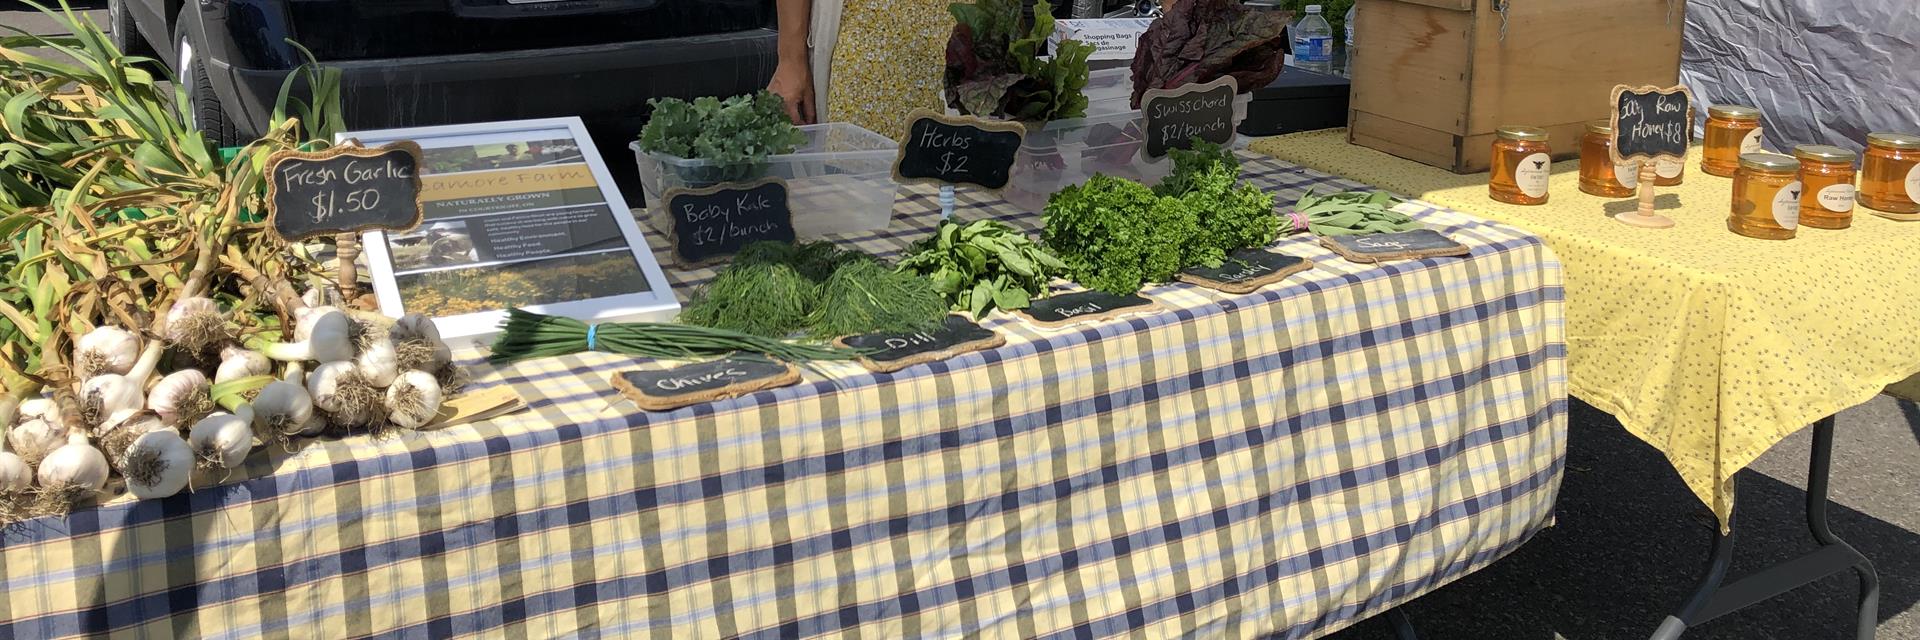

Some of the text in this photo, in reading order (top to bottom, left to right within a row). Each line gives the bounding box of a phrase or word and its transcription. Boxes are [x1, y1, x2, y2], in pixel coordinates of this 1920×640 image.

[1656, 95, 1681, 115] Raw
[919, 122, 972, 149] Herbs
[1631, 121, 1665, 141] Honey
[935, 151, 969, 175] $2
[283, 160, 412, 192] Fresh Garlic
[516, 169, 585, 184] Farm
[312, 188, 380, 223] $1.50
[436, 191, 551, 207] NATURALLY GROWN
[683, 203, 730, 222] Baby
[884, 331, 936, 349] Dill
[656, 367, 747, 391] Chives
